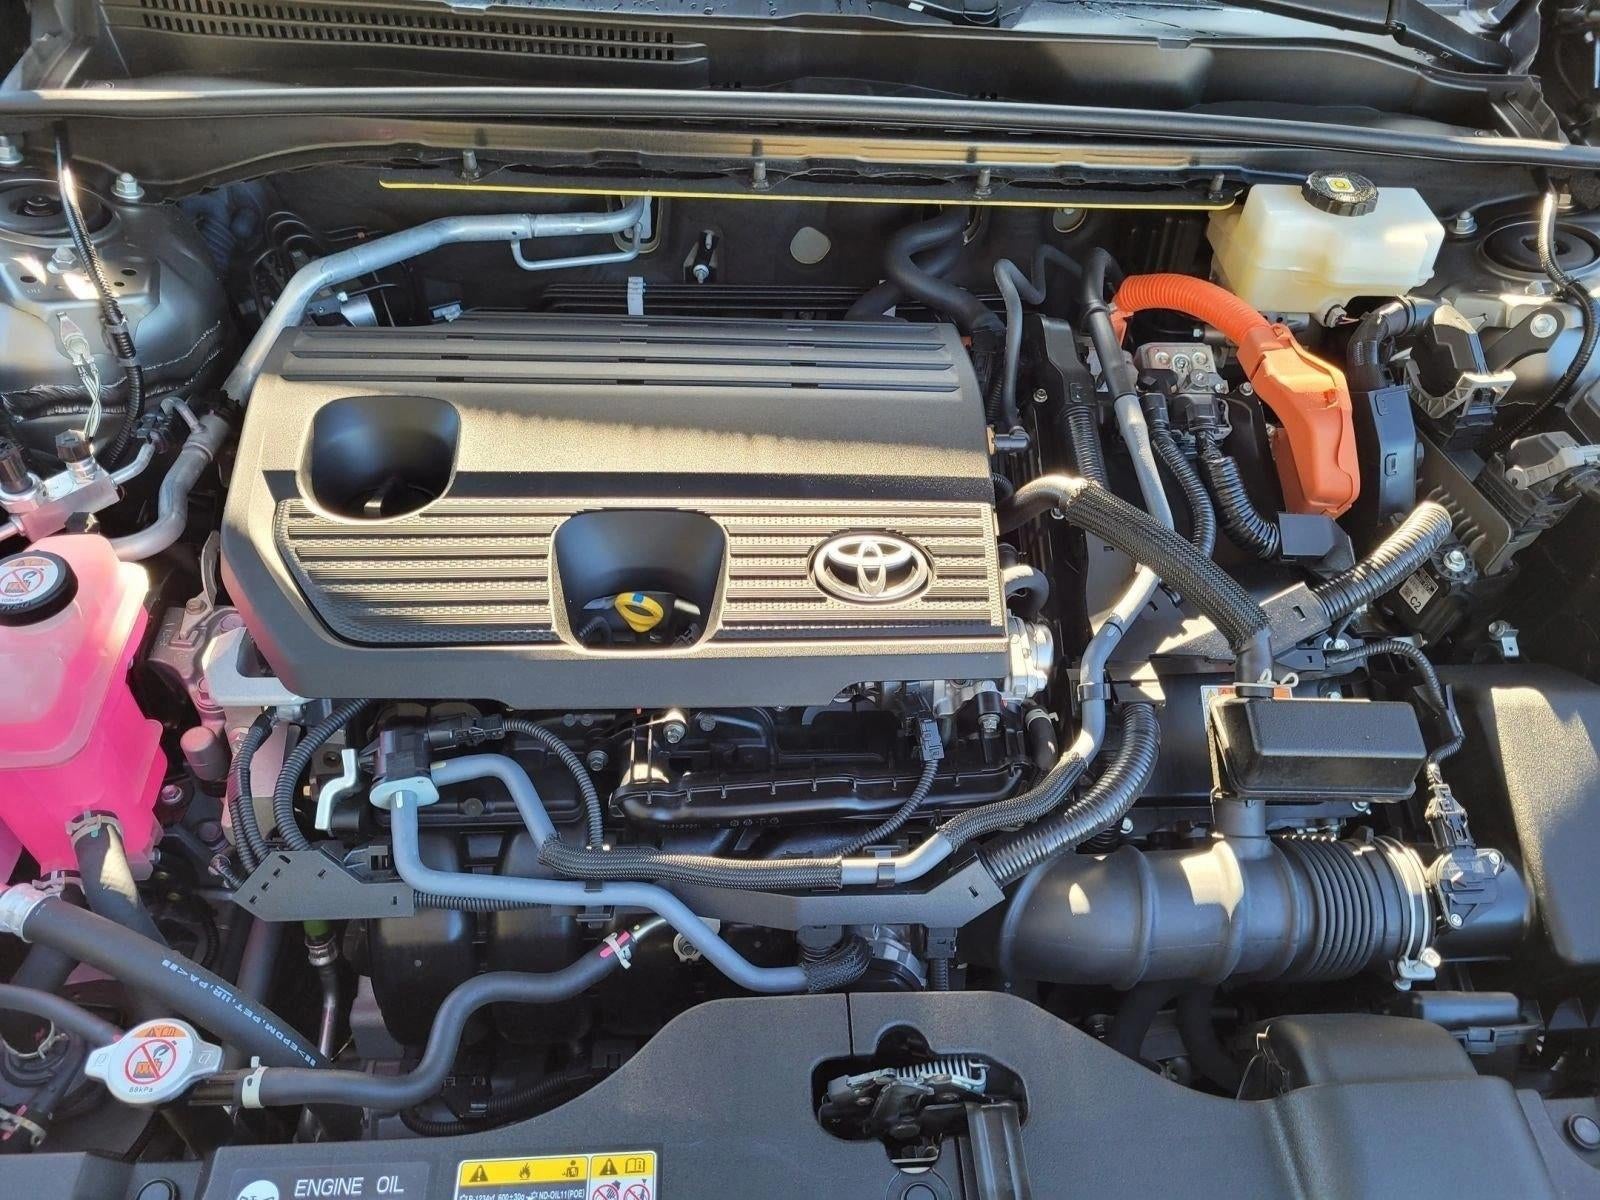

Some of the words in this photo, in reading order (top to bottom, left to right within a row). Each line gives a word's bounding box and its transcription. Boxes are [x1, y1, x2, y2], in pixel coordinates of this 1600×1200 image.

[1410, 596, 1421, 610] C2
[294, 1177, 364, 1197] ENGINE
[376, 1175, 404, 1193] OIL
